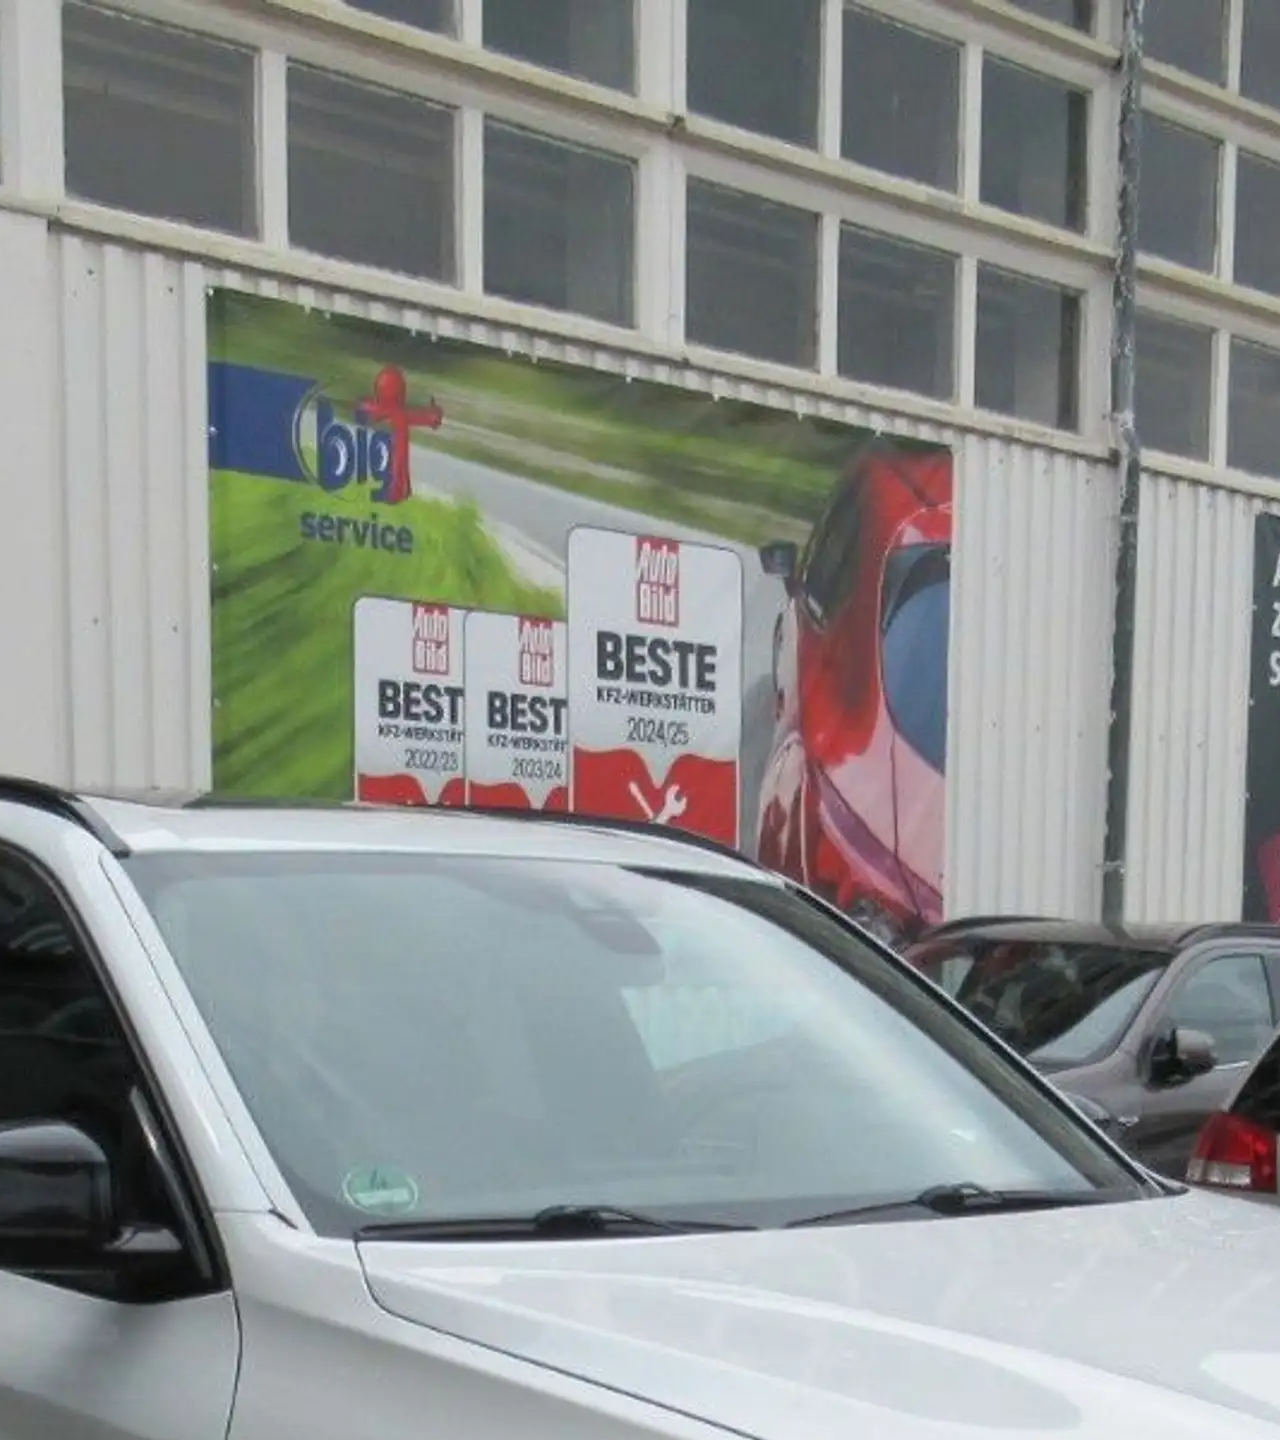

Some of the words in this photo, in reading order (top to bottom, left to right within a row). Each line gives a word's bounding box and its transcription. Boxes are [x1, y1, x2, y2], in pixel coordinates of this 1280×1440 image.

[300, 512, 413, 554] service
[637, 541, 677, 586] Auto
[413, 605, 448, 642] Auto
[639, 583, 677, 625] Bild
[415, 640, 448, 673] Bild
[521, 652, 553, 685] Bild
[597, 631, 717, 692] BESTE
[378, 679, 464, 725] BEST
[487, 691, 568, 735] BEST
[627, 717, 689, 747] 2024/25
[404, 747, 458, 772] 2022/23
[512, 757, 562, 780] 2023/24
